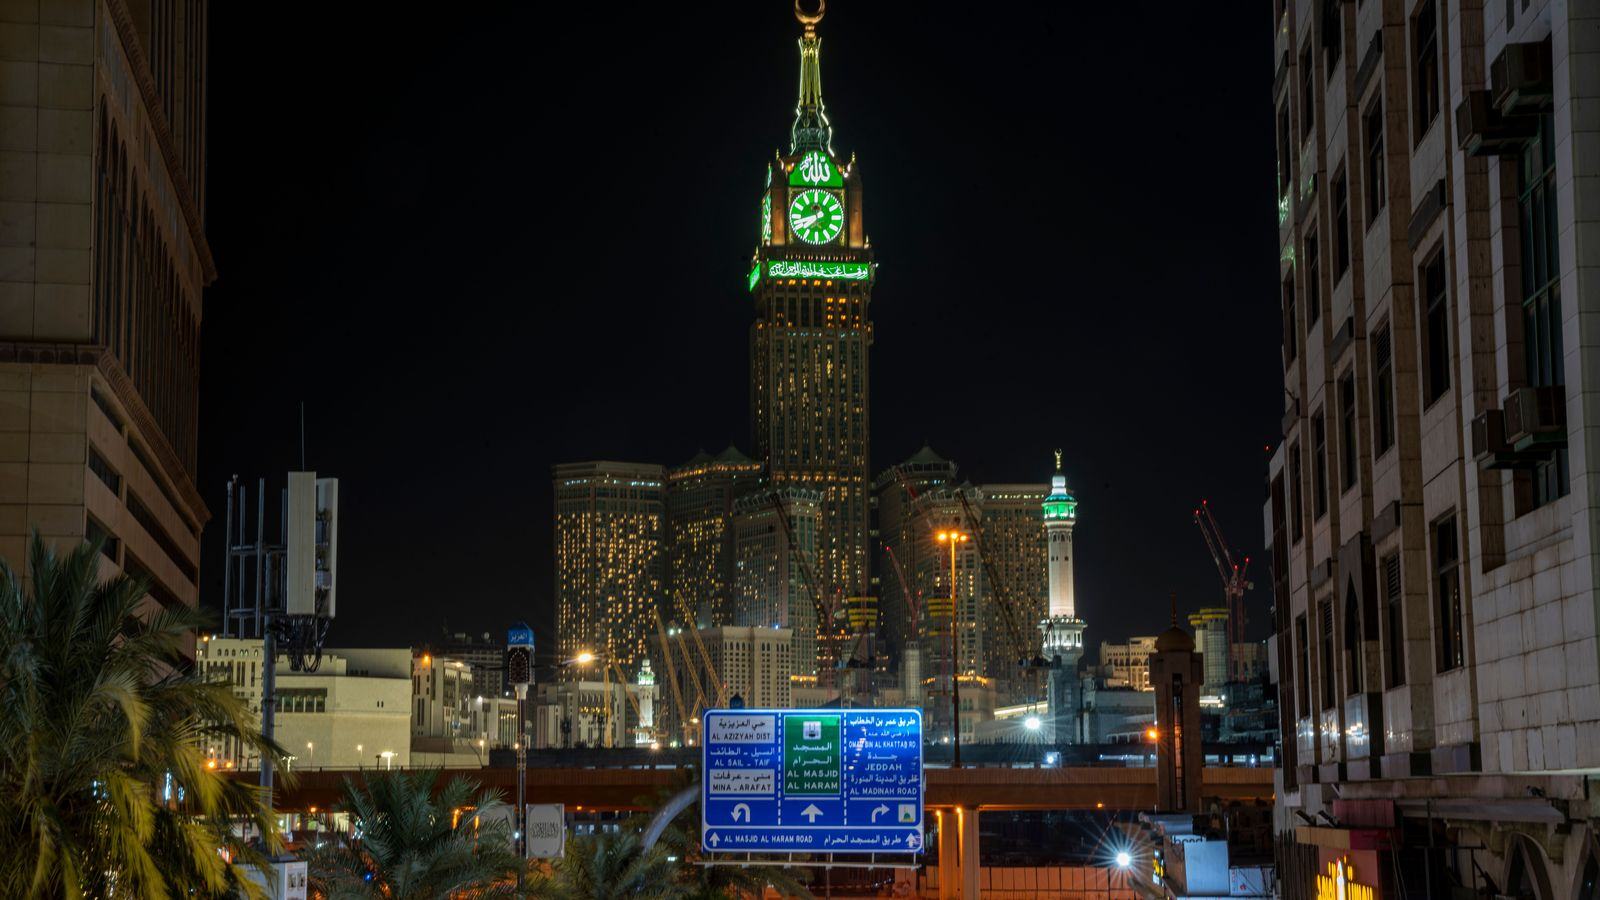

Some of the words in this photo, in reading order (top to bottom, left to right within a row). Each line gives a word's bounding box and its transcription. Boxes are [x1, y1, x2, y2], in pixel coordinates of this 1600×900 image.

[719, 718, 751, 729] العزيزية
[752, 721, 765, 731] حي
[850, 716, 875, 727] الخطاب
[875, 717, 883, 727] بن
[885, 718, 897, 727] عمر
[898, 716, 916, 727] طريق
[710, 746, 741, 756] الطائف
[793, 741, 832, 752] المسجد
[751, 747, 775, 757] السيل
[867, 752, 898, 761] جدة
[792, 755, 832, 767] الحرام
[713, 771, 742, 781] عرفات
[753, 773, 771, 782] منى
[851, 774, 873, 784] المنورة
[875, 774, 897, 784] المدينة
[898, 774, 918, 785] طريق
[824, 834, 849, 846] الحرام
[850, 834, 880, 845] المسجد
[882, 834, 901, 846] طريق
